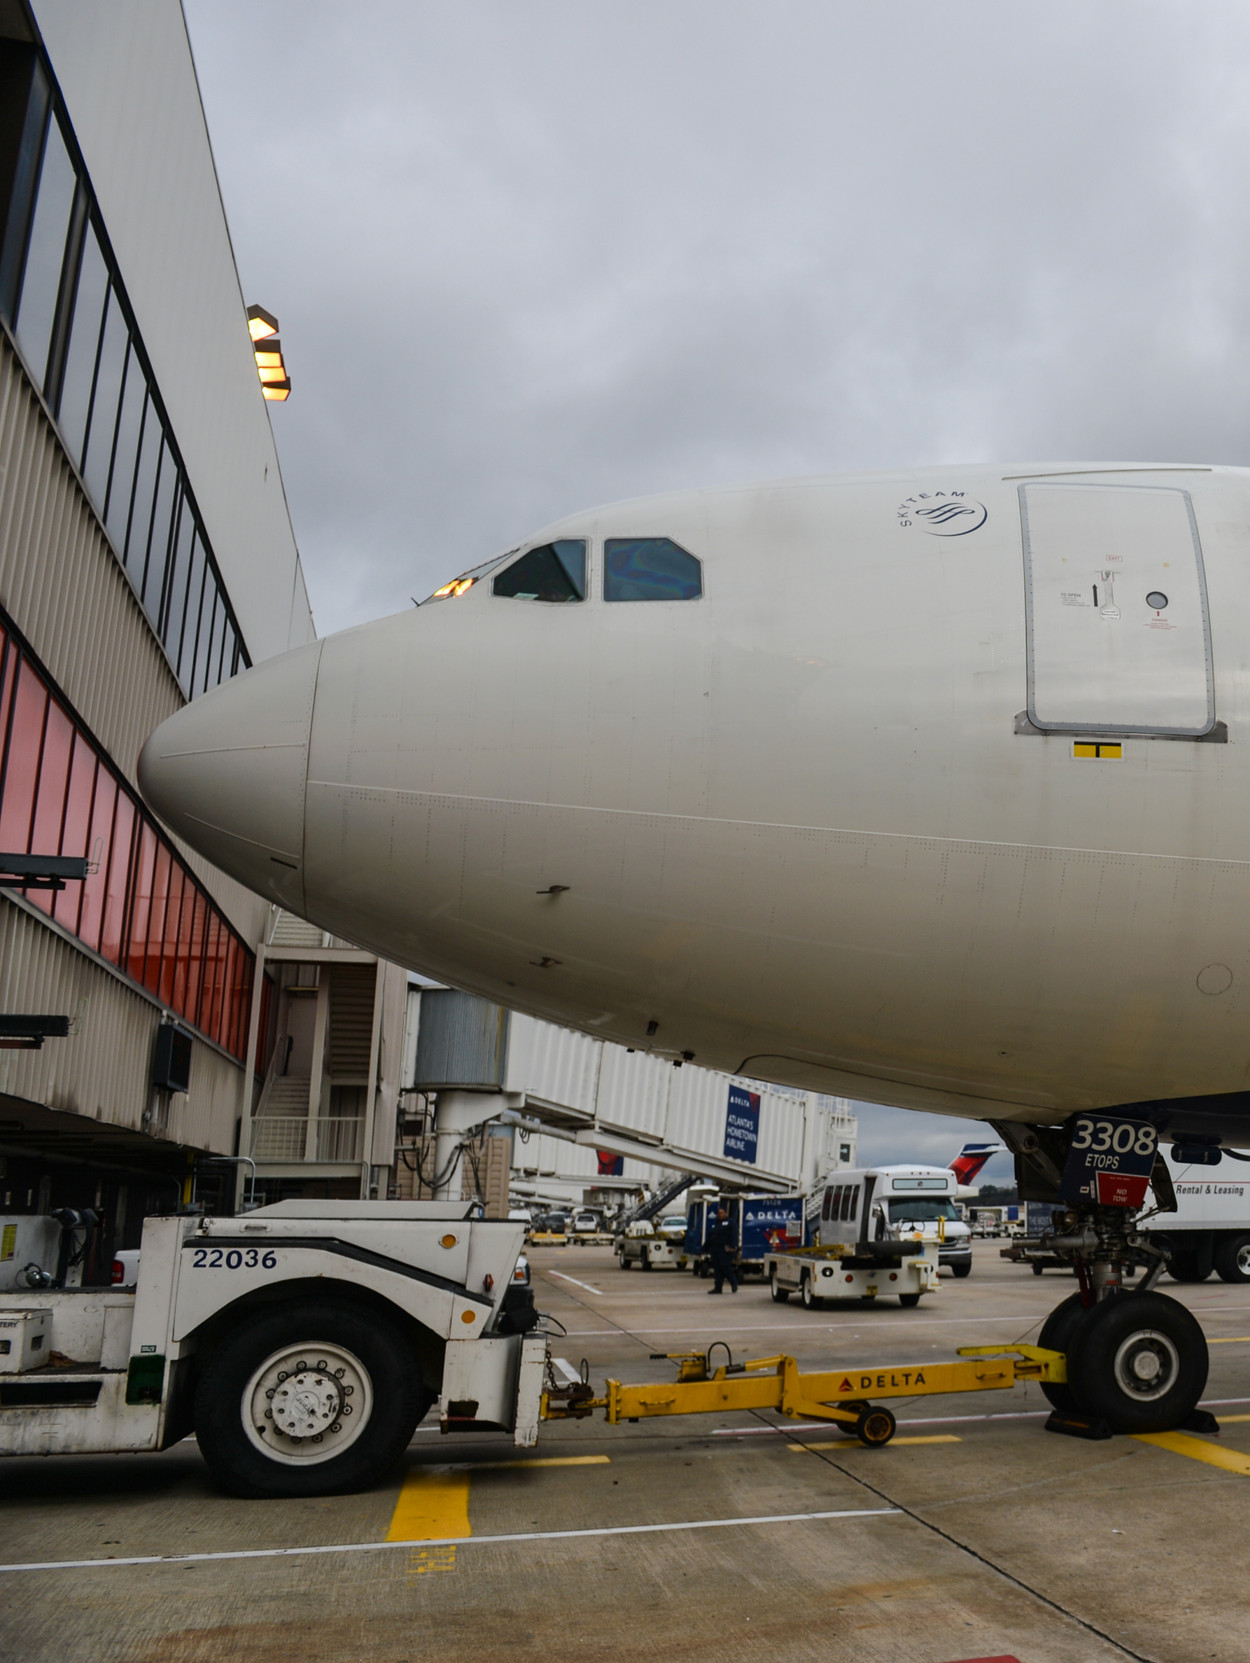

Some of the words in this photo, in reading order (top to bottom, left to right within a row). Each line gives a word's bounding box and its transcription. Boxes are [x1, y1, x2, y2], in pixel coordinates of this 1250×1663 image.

[897, 491, 965, 527] SKYTEAM
[734, 1096, 750, 1107] DELTA
[728, 1114, 754, 1131] ATLANTA'S
[727, 1126, 757, 1142] HOMETOWN
[1071, 1119, 1157, 1156] 3308
[1084, 1153, 1120, 1169] ETOPS
[1176, 1184, 1203, 1195] Rental
[1205, 1185, 1211, 1195] &
[1213, 1184, 1244, 1197] Leasing
[1112, 1195, 1128, 1203] TOW
[757, 1211, 796, 1220] DELTA
[192, 1249, 277, 1270] 22036
[860, 1372, 926, 1389] DELTA
